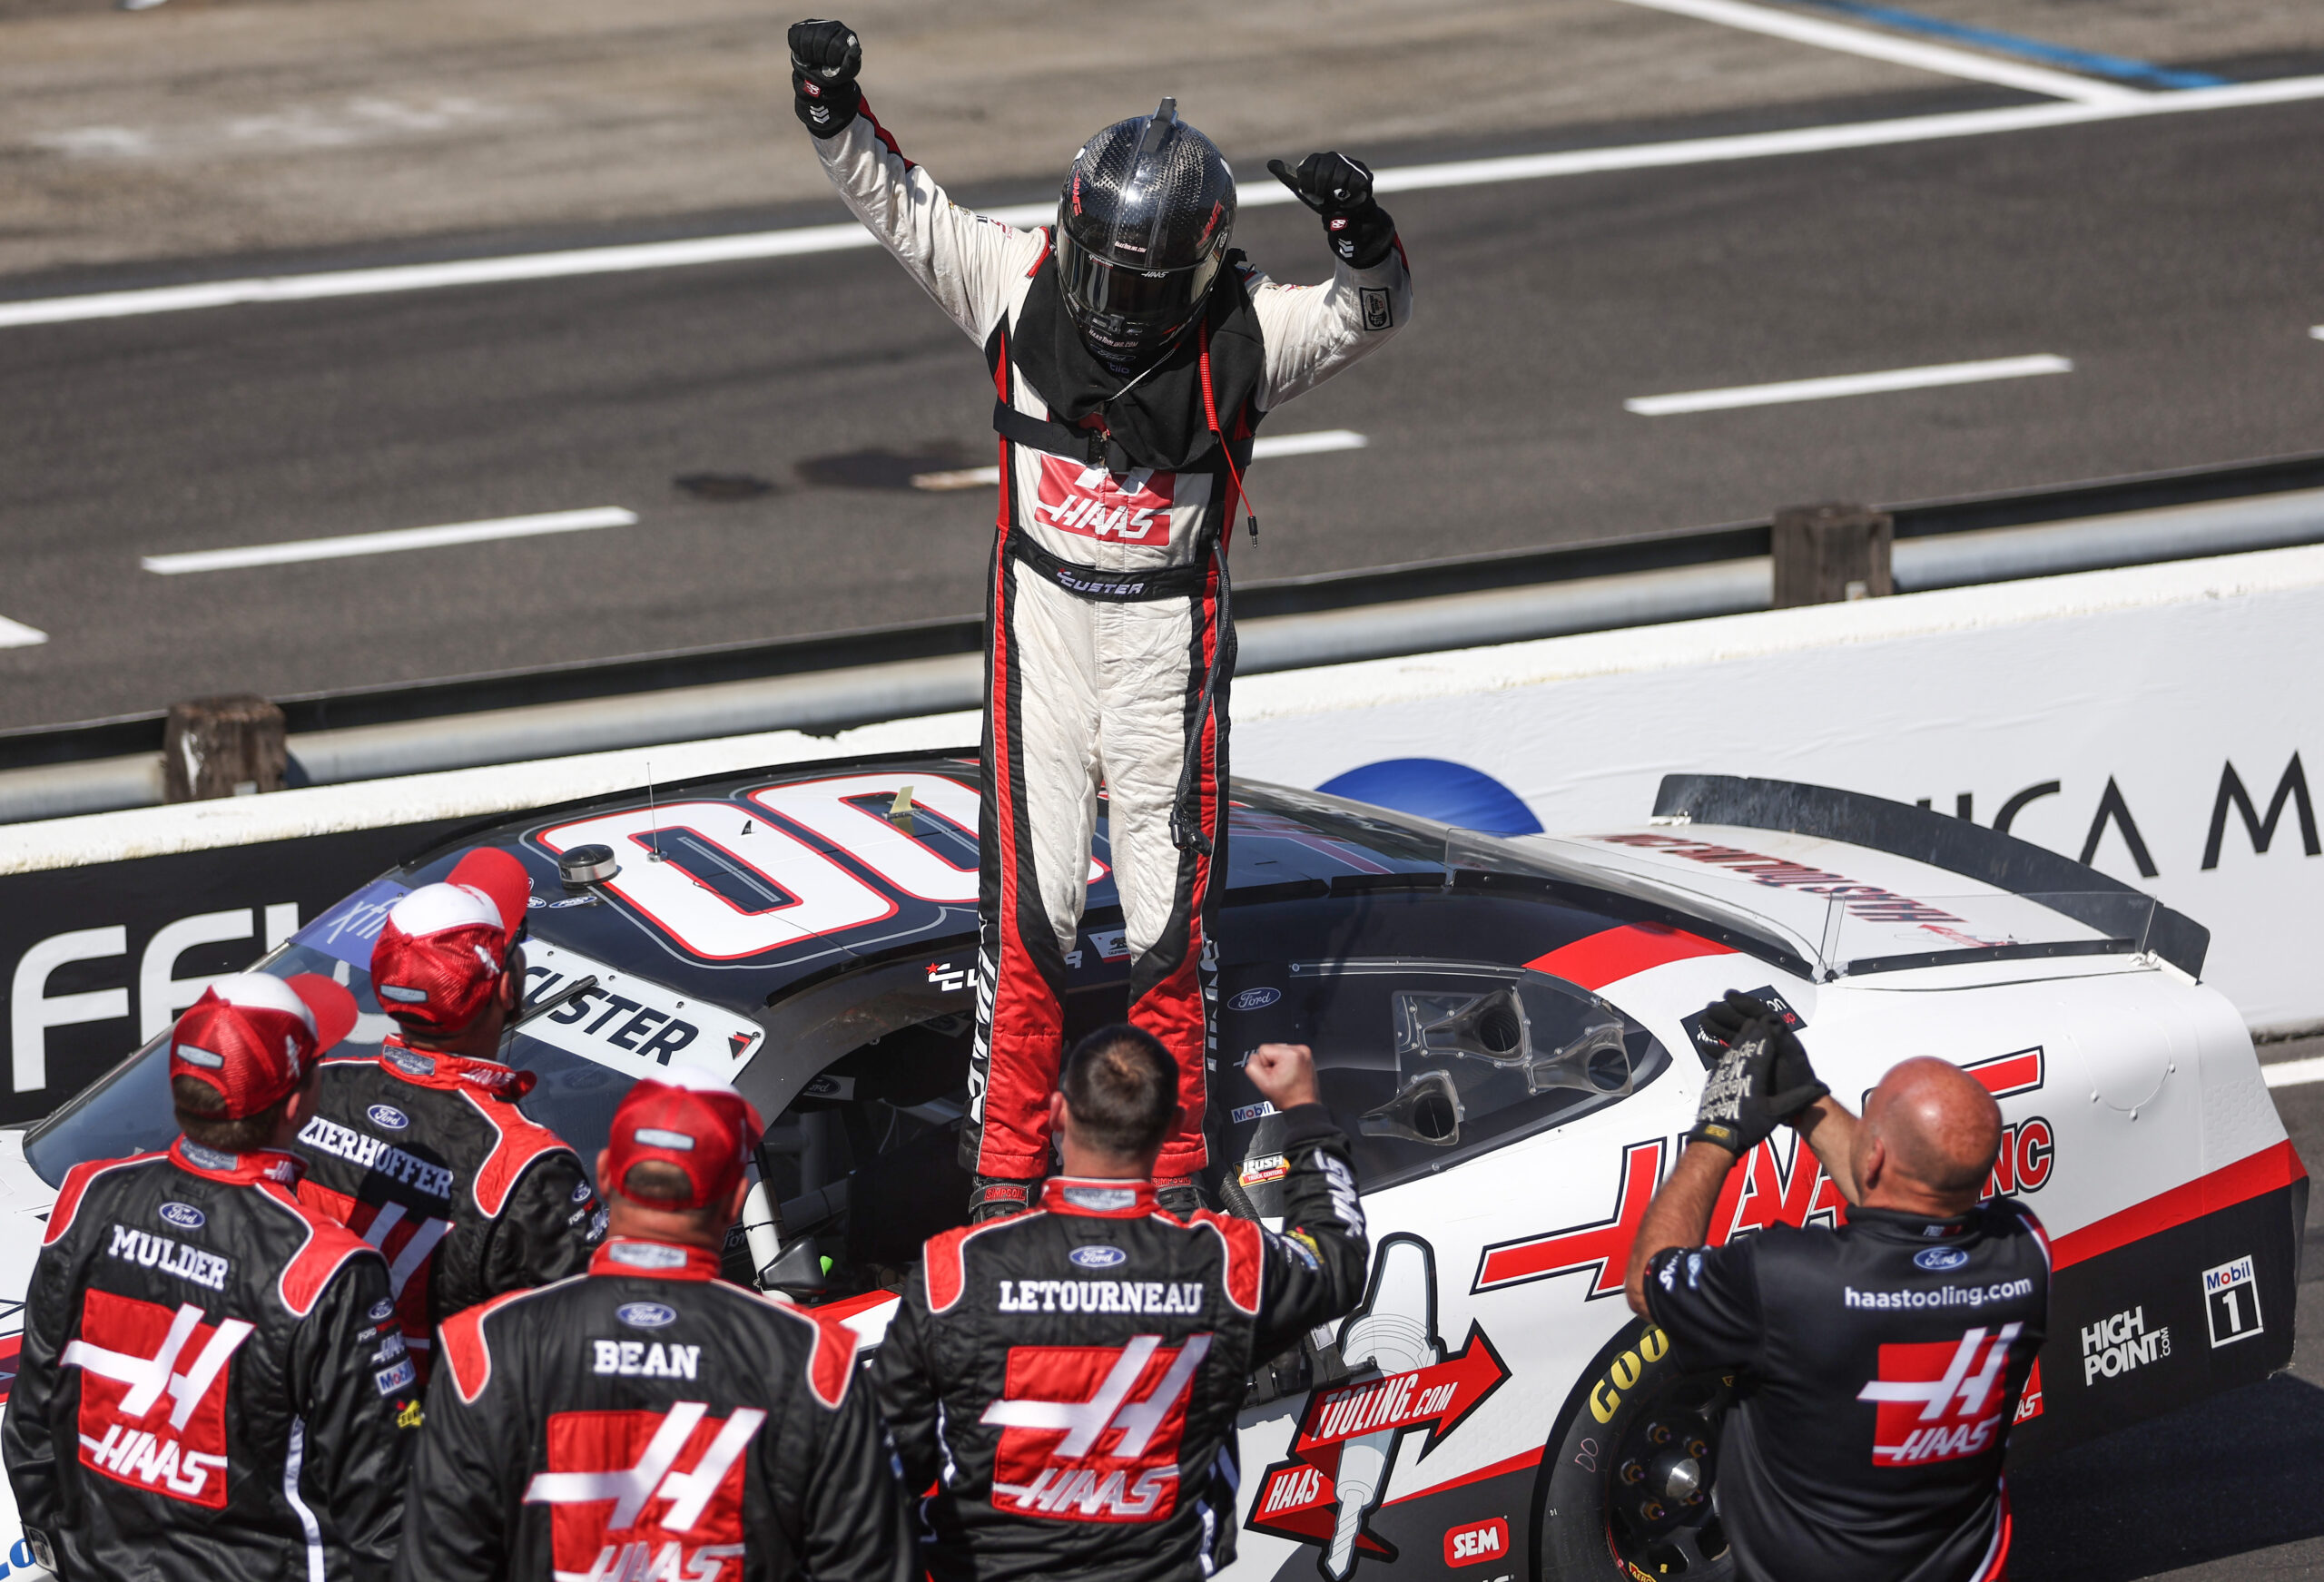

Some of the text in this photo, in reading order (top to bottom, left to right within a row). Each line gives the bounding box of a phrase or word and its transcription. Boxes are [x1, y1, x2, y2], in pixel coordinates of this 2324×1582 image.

[1030, 494, 1172, 539] HAAS
[1234, 1105, 1270, 1124] Mobil
[297, 1115, 454, 1199] ZIERHOFFER
[1243, 1155, 1285, 1174] RUSH
[985, 1187, 1025, 1202] SIMPSON
[108, 1224, 229, 1291] MULDER
[2206, 1261, 2251, 1290] Mobil
[1000, 1280, 1203, 1315] LETOURNEAU
[1845, 1277, 2034, 1308] haastooling.com
[2221, 1290, 2241, 1333] 1
[2081, 1305, 2145, 1356] HIGH
[595, 1339, 701, 1380] BEAN
[2084, 1326, 2171, 1387] POINT .COM
[1311, 1372, 1459, 1442] TOOLING.COM
[1873, 1412, 2001, 1461] HAAS
[79, 1424, 228, 1496] HAAS
[991, 1465, 1180, 1515] HAAS
[1265, 1468, 1324, 1513] HAAS
[1452, 1527, 1500, 1559] SEM
